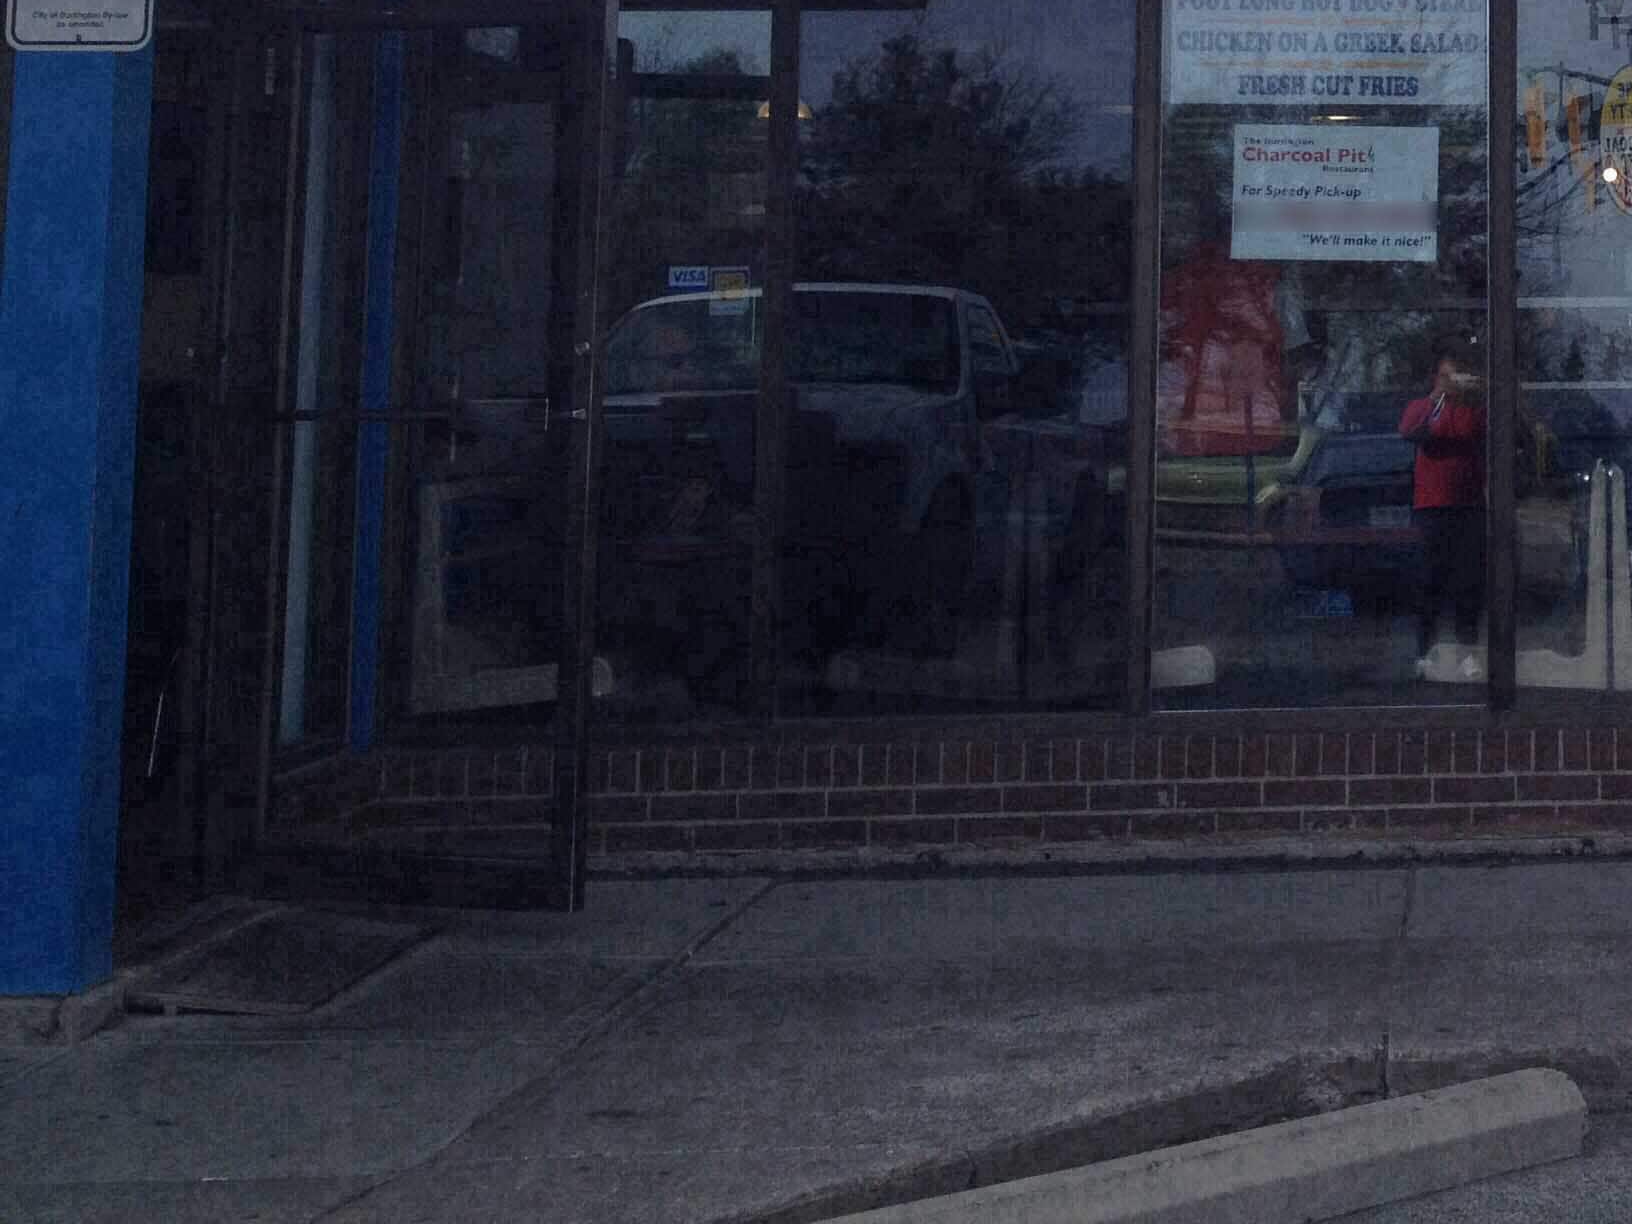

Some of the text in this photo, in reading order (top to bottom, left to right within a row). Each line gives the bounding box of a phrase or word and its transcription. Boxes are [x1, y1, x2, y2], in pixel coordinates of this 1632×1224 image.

[1177, 31, 1273, 53] CHICKEN
[1278, 31, 1309, 53] ON
[1313, 31, 1329, 53] A
[1334, 31, 1404, 54] GREEK
[1239, 75, 1420, 97] FRESH CUT FRIES
[1242, 146, 1368, 163] Charcoal Pit
[1241, 184, 1362, 200] For Speedy Pick-up
[1343, 235, 1378, 247] make
[1381, 235, 1391, 247] it
[673, 270, 706, 283] VISA
